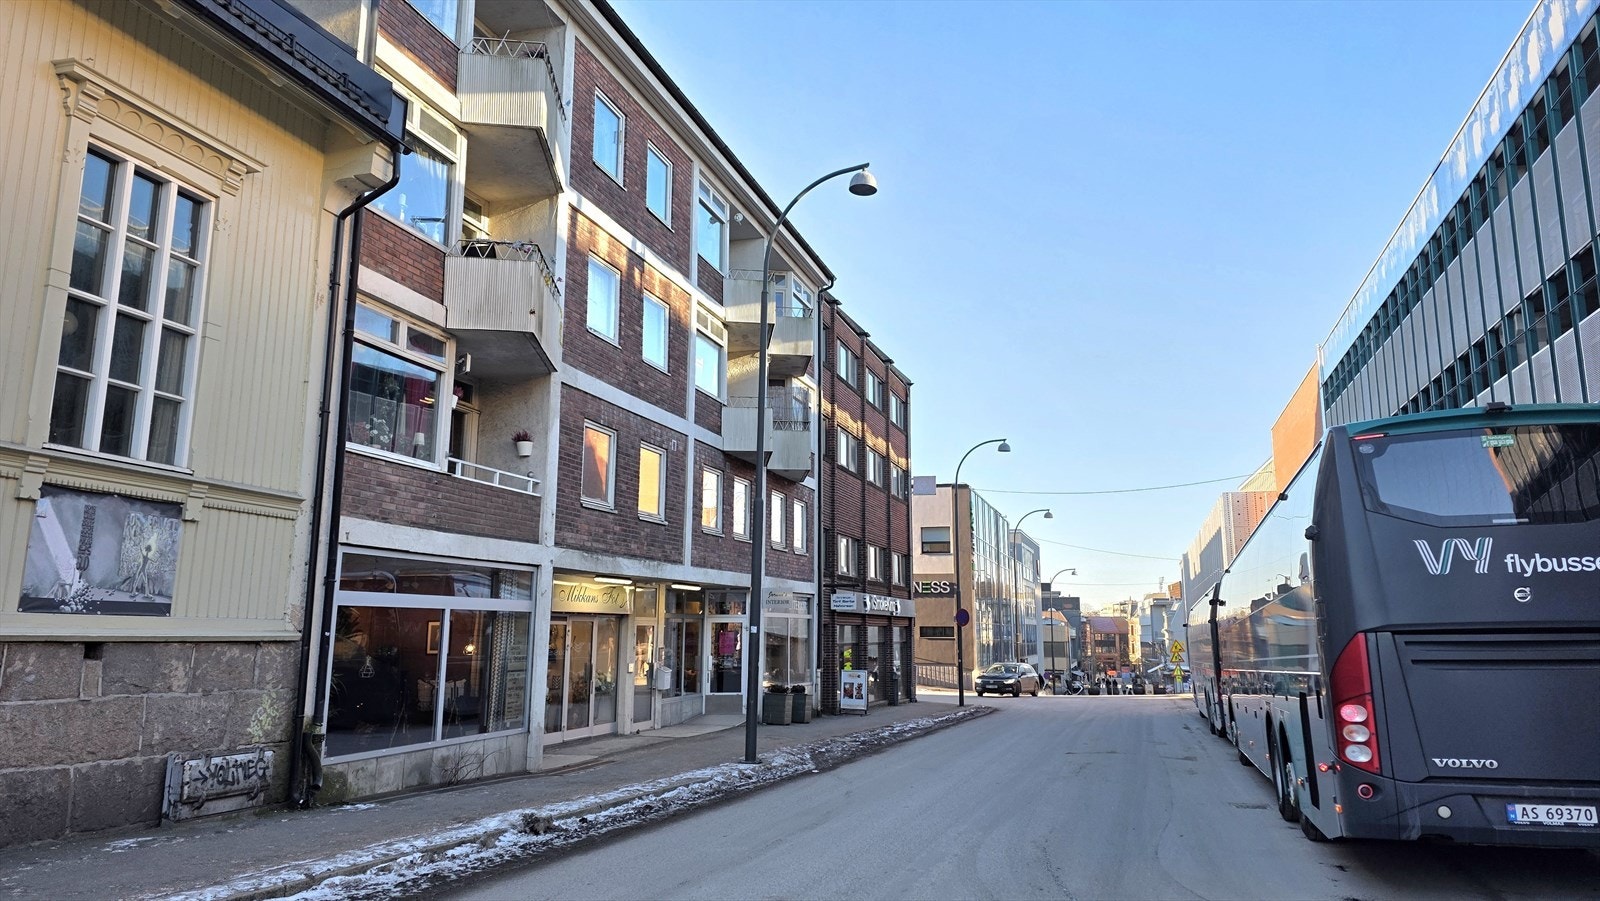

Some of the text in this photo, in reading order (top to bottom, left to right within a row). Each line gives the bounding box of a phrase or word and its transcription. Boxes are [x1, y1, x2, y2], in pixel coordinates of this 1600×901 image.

[1412, 537, 1493, 575] VY
[558, 585, 598, 604] Mikkans
[1432, 758, 1498, 769] VOLVO
[1521, 806, 1593, 821] AS 69370
